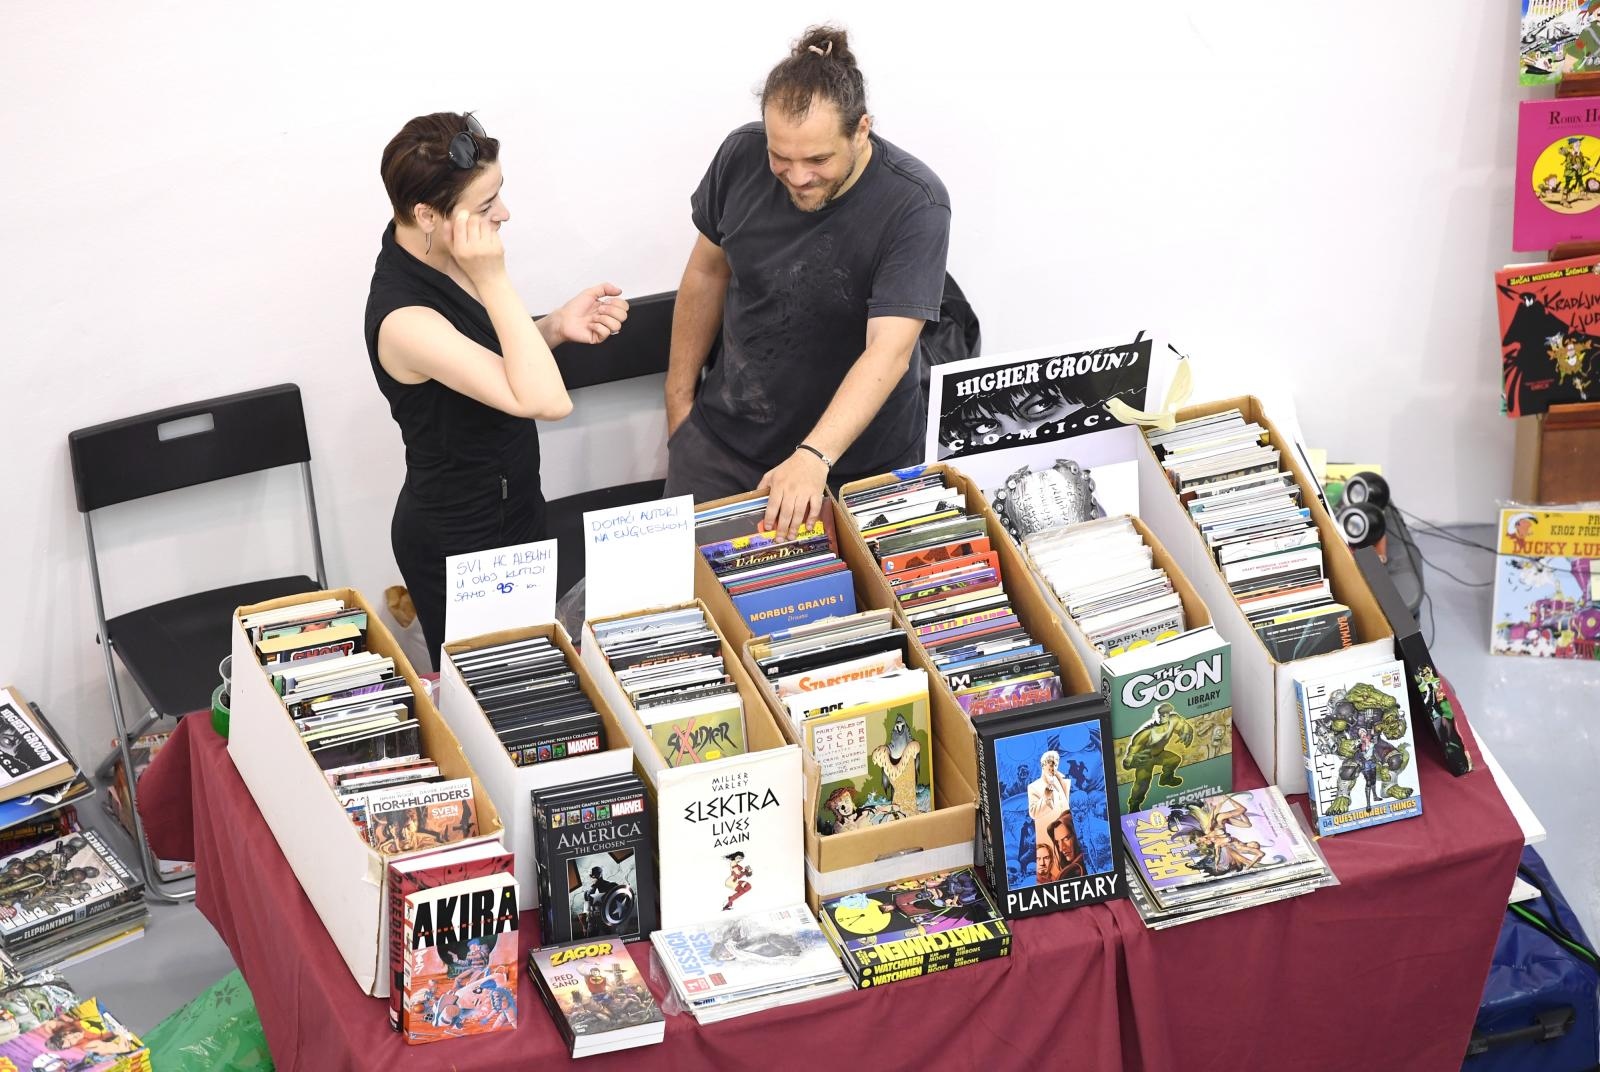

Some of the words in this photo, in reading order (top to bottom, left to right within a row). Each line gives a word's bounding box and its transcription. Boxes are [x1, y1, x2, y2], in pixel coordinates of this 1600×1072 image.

[956, 363, 1043, 397] HIGHER
[640, 506, 678, 521] AUTORI
[594, 534, 609, 544] NA
[614, 520, 688, 539] ENGLESKOM
[1550, 525, 1575, 536] KROZ
[456, 560, 481, 576] SVI
[456, 578, 464, 589] U
[454, 590, 486, 602] SAMO
[750, 606, 794, 622] MORBUS
[798, 596, 837, 610] GRAVIS
[840, 594, 844, 602] I
[1108, 632, 1138, 646] DARK
[1141, 619, 1178, 635] HORSE
[1121, 653, 1223, 708] GOON
[1153, 664, 1184, 680] THE
[1187, 688, 1221, 707] LIBRARY
[1, 708, 30, 734] HIGHER
[23, 732, 52, 762] GROUND
[816, 728, 865, 744] OSCAR
[816, 736, 865, 752] WILDE
[567, 736, 599, 755] MARVEL
[712, 772, 748, 786] MILLER
[712, 780, 748, 792] VARLEY
[560, 804, 580, 812] ULTIMATE
[582, 800, 600, 808] GRAPHIC
[617, 793, 644, 802] COLLECTION
[1178, 785, 1224, 804] POWELL
[432, 805, 458, 816] SVEN
[611, 798, 644, 818] MARVEL
[684, 788, 780, 823] ELEKTRA
[1334, 806, 1388, 826] QUESTIONABLE
[1390, 799, 1416, 813] THINGS
[584, 820, 612, 830] CAPTAIN
[712, 817, 750, 836] LIVES
[83, 832, 109, 856] FORCES
[556, 822, 642, 849] AMERICA
[714, 832, 750, 848] AGAIN
[574, 846, 590, 855] THE
[592, 839, 626, 852] CHOSEN
[107, 855, 130, 879] ARMED
[1006, 873, 1118, 914] PLANETARY
[24, 914, 74, 940] ELEPHANTMEN
[412, 885, 519, 950] AKIRA
[874, 924, 994, 964] WATCHMEN
[956, 946, 981, 956] GIBBONS
[549, 943, 613, 968] ZAGOR
[664, 932, 705, 976] JESSICA
[928, 954, 950, 962] MOORE
[954, 956, 979, 968] GIBBONS
[874, 954, 924, 975] WATCHMEN
[928, 964, 949, 973] MOORE
[552, 979, 579, 989] SAND
[554, 974, 574, 982] RED
[872, 966, 922, 986] WATCHMEN
